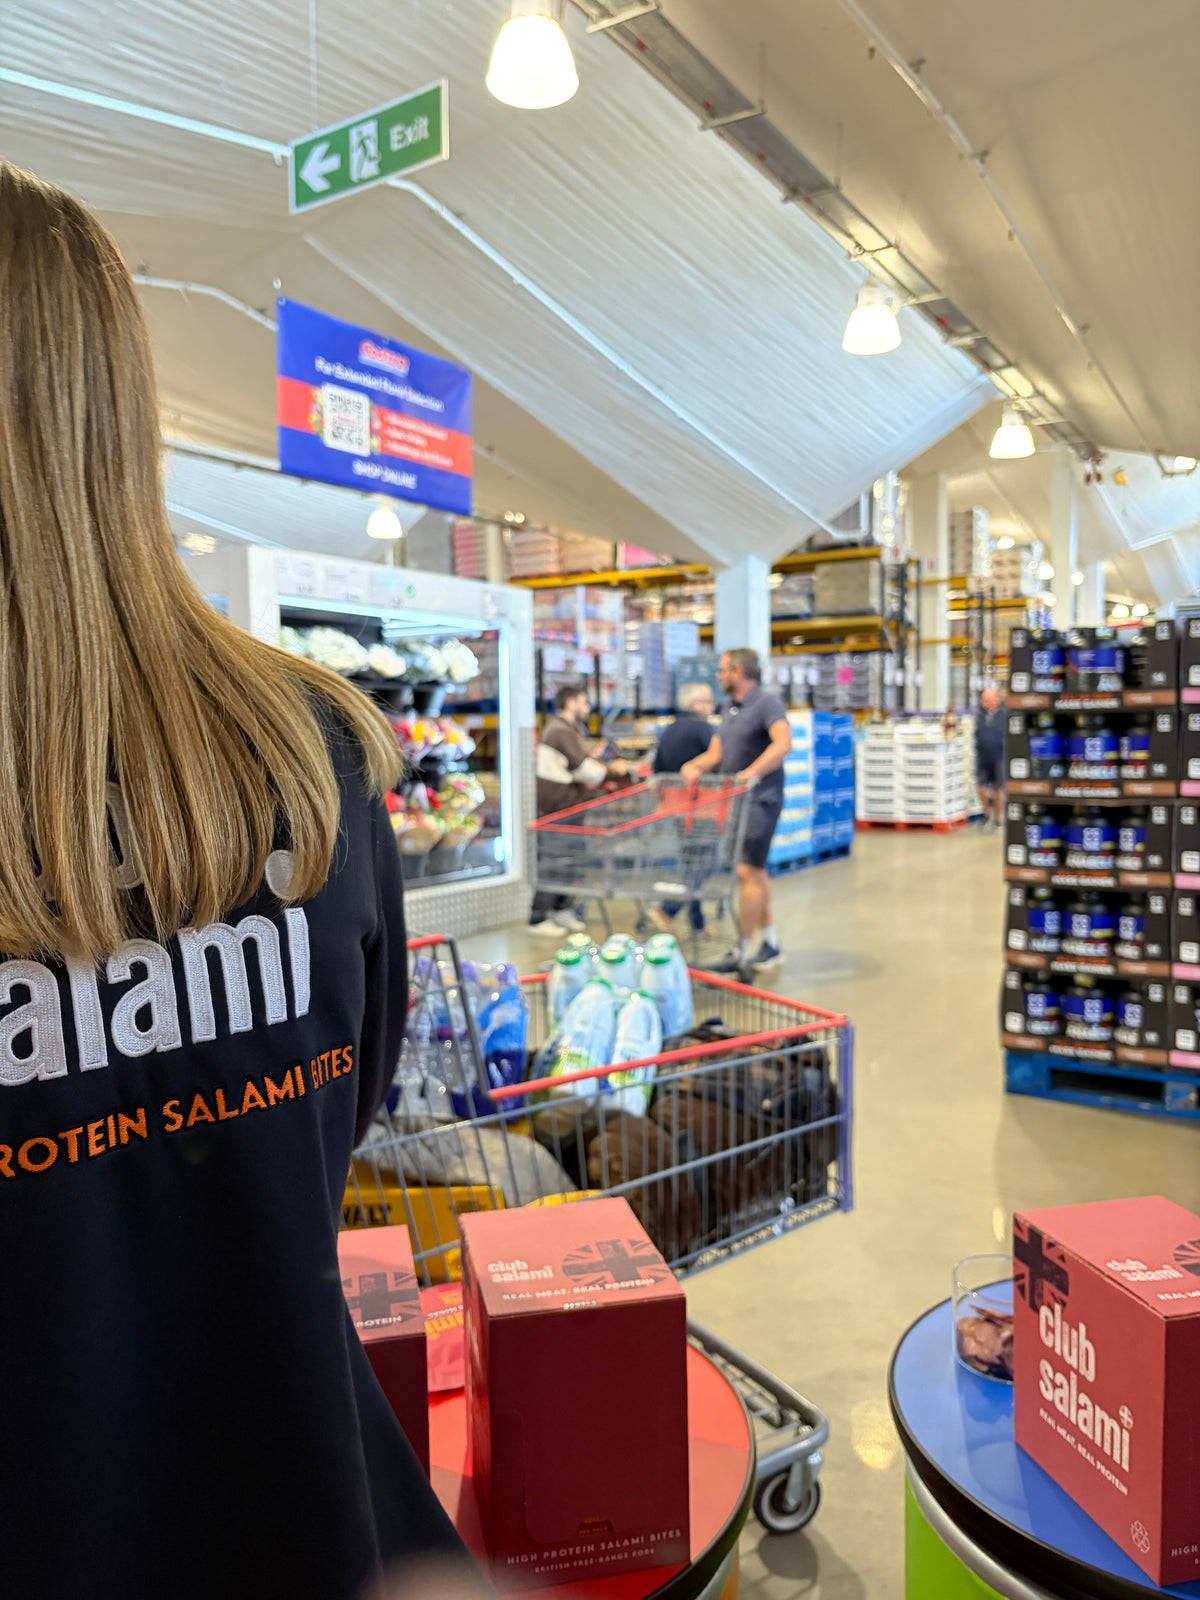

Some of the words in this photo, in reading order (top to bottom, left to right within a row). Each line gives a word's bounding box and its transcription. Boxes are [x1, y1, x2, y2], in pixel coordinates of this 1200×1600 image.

[390, 115, 429, 152] Exit
[0, 849, 310, 1087] alami
[0, 1107, 148, 1179] ROTEIN
[162, 1065, 306, 1133] SALAMI
[311, 1045, 354, 1090] BITES
[488, 1259, 528, 1273] club
[492, 1265, 554, 1282] salami
[1106, 1259, 1147, 1271] club
[1121, 1264, 1183, 1281] salami
[502, 1292, 533, 1300] REAL
[573, 1285, 603, 1295] REAL
[605, 1278, 656, 1291] PROTEIN
[1157, 1292, 1187, 1300] REAL
[356, 1314, 402, 1328] ROTEIN
[1039, 1302, 1096, 1383] club
[1039, 1359, 1134, 1473] salami
[1039, 1407, 1056, 1430] REAL
[1077, 1443, 1096, 1467] REAL
[1096, 1460, 1128, 1496] PROTEIN
[507, 1553, 538, 1565] HIGH
[543, 1544, 595, 1560] PROTEIN
[600, 1536, 645, 1551] SALAMI
[650, 1528, 682, 1542] BITES
[1171, 1544, 1198, 1557] HIGH
[534, 1562, 570, 1574] BRITISH
[573, 1553, 629, 1568] FREE-RANGE
[632, 1548, 656, 1558] PORK
